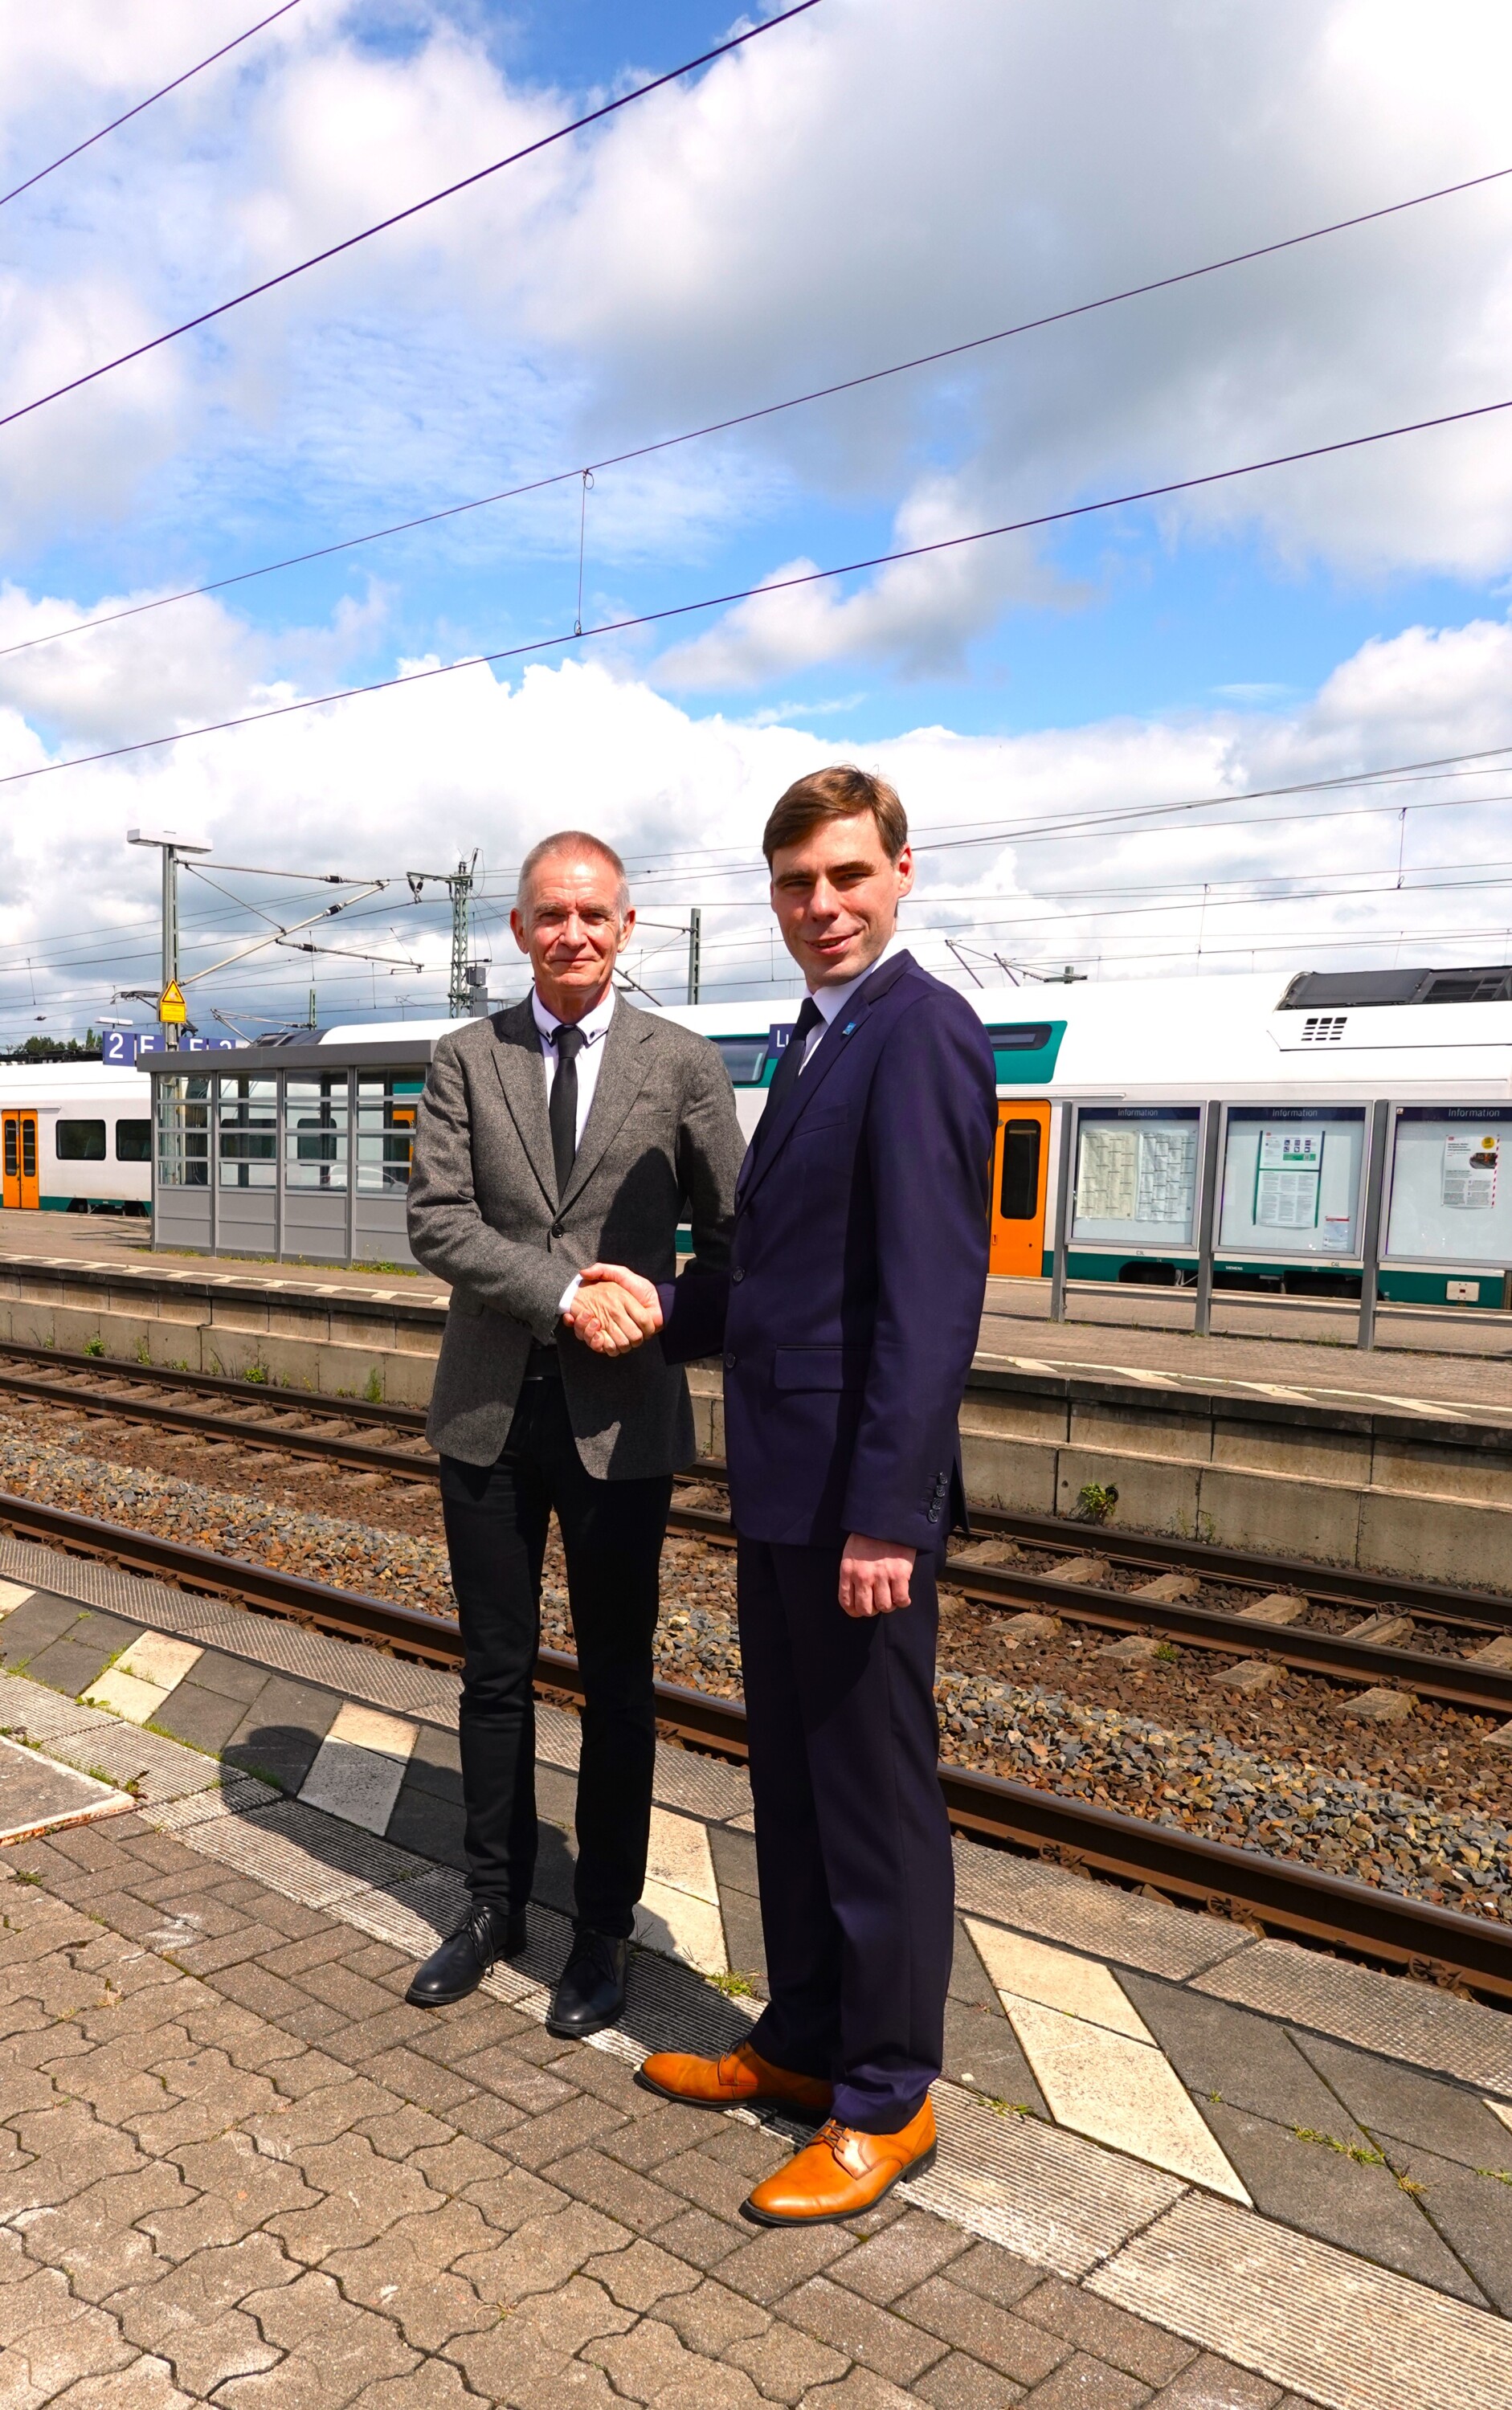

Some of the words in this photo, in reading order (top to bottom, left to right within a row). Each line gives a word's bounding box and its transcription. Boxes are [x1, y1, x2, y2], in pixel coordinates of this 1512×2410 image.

[109, 1033, 124, 1059] 2
[1118, 1109, 1159, 1117] Information
[1272, 1109, 1318, 1117] Information
[1448, 1109, 1500, 1117] Information
